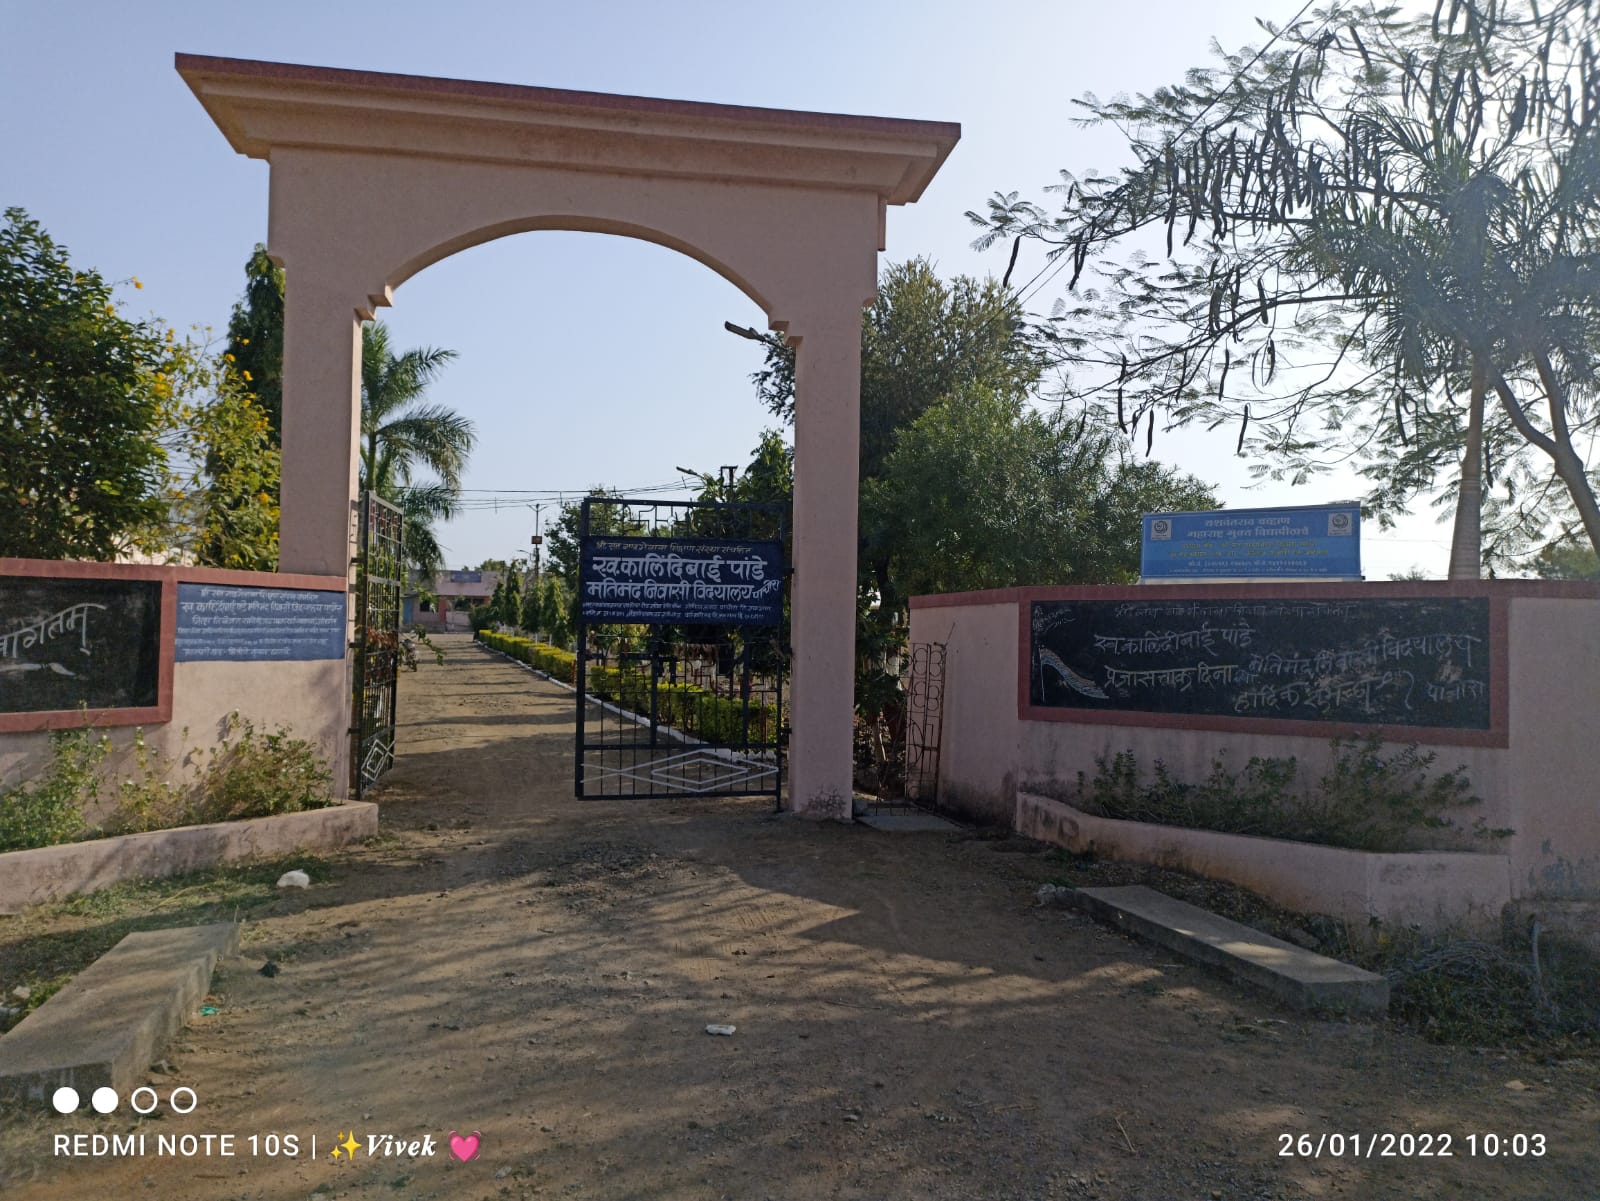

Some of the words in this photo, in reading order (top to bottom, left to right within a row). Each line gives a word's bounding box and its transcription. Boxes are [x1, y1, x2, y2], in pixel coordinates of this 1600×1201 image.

[726, 554, 768, 581] पांडे
[585, 577, 643, 601] मतिमंद
[643, 578, 692, 601] निवासी
[1221, 617, 1257, 648] पांडे
